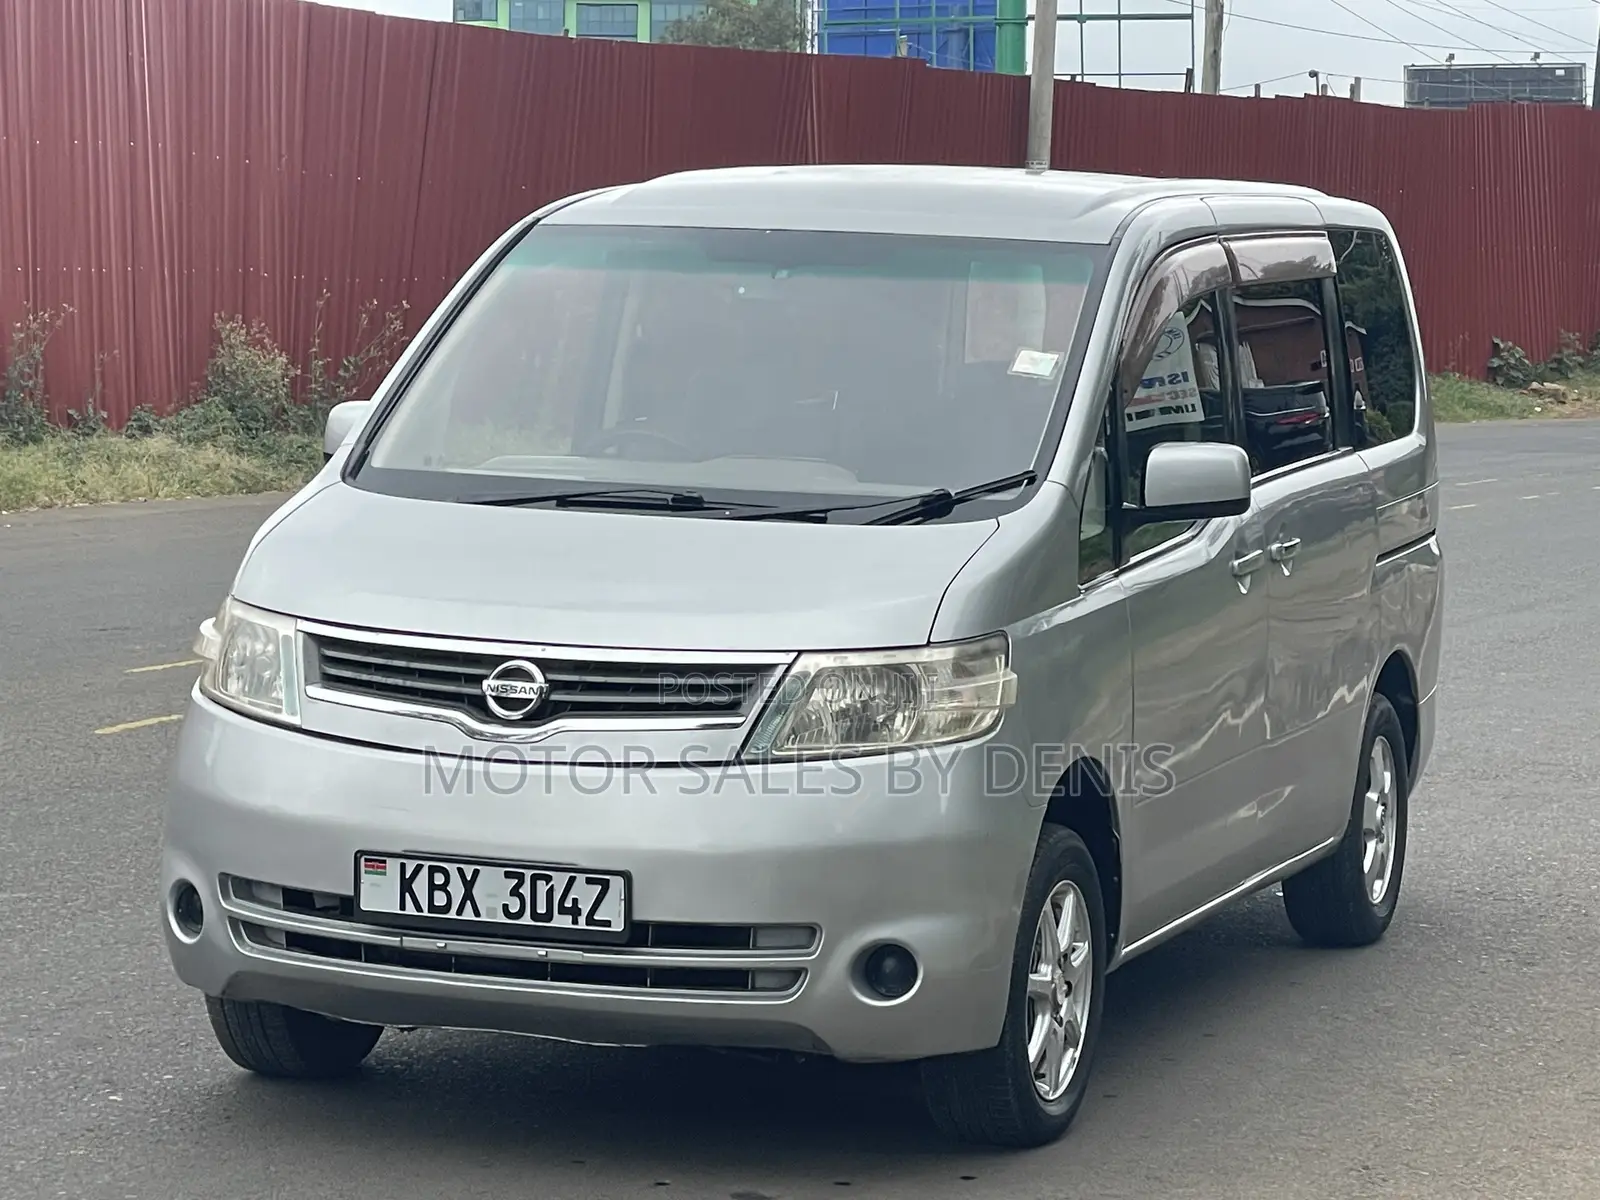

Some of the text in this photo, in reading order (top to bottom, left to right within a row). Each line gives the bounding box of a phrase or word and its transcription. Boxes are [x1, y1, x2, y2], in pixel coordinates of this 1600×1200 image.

[486, 683, 541, 696] NISSAN
[399, 861, 612, 928] KBX 304Z
